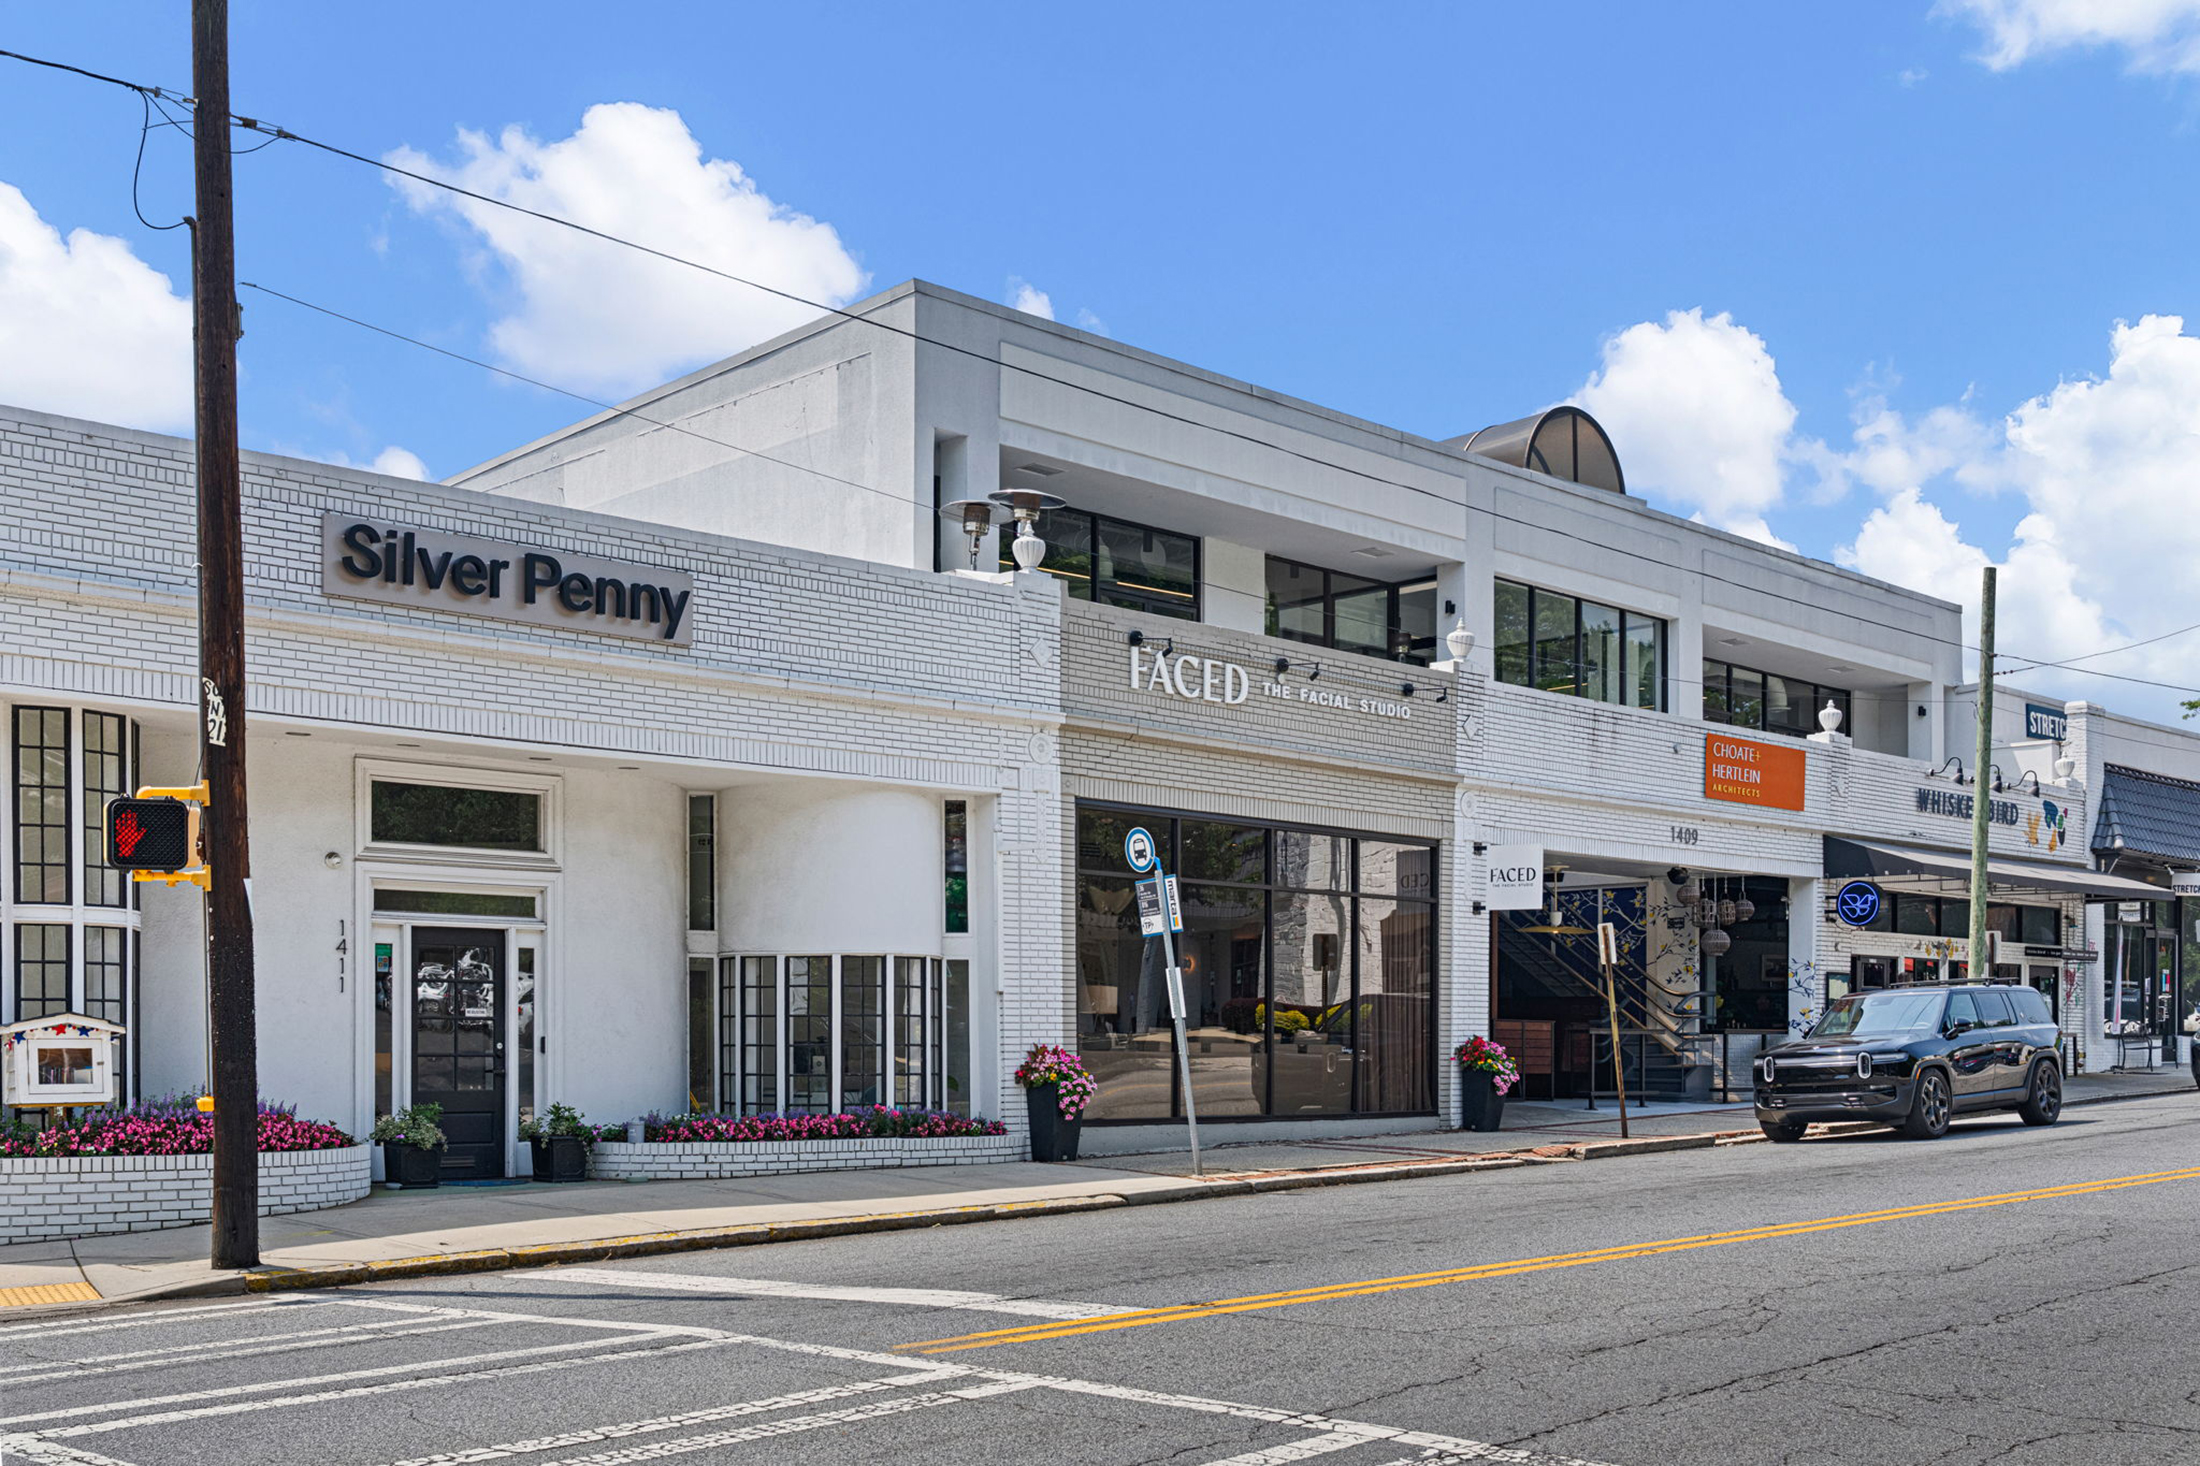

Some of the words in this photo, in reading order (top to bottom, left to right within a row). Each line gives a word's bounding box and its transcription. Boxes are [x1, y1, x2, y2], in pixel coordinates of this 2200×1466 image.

[341, 523, 510, 599] Silver
[523, 552, 691, 640] Penny
[1130, 644, 1249, 704] FACED
[1262, 682, 1291, 699] THE
[1300, 688, 1352, 710] FACIAL
[1359, 699, 1411, 719] STUDIO
[2030, 711, 2066, 740] STRETC
[1712, 763, 1761, 784] HERTLEIN
[1712, 783, 1761, 798] ARCHITECTS
[1917, 787, 1974, 819] WHISKE
[1671, 825, 1698, 846] 1409
[1490, 867, 1536, 883] FACED
[1167, 880, 1178, 916] marta
[336, 919, 347, 993] 1411
